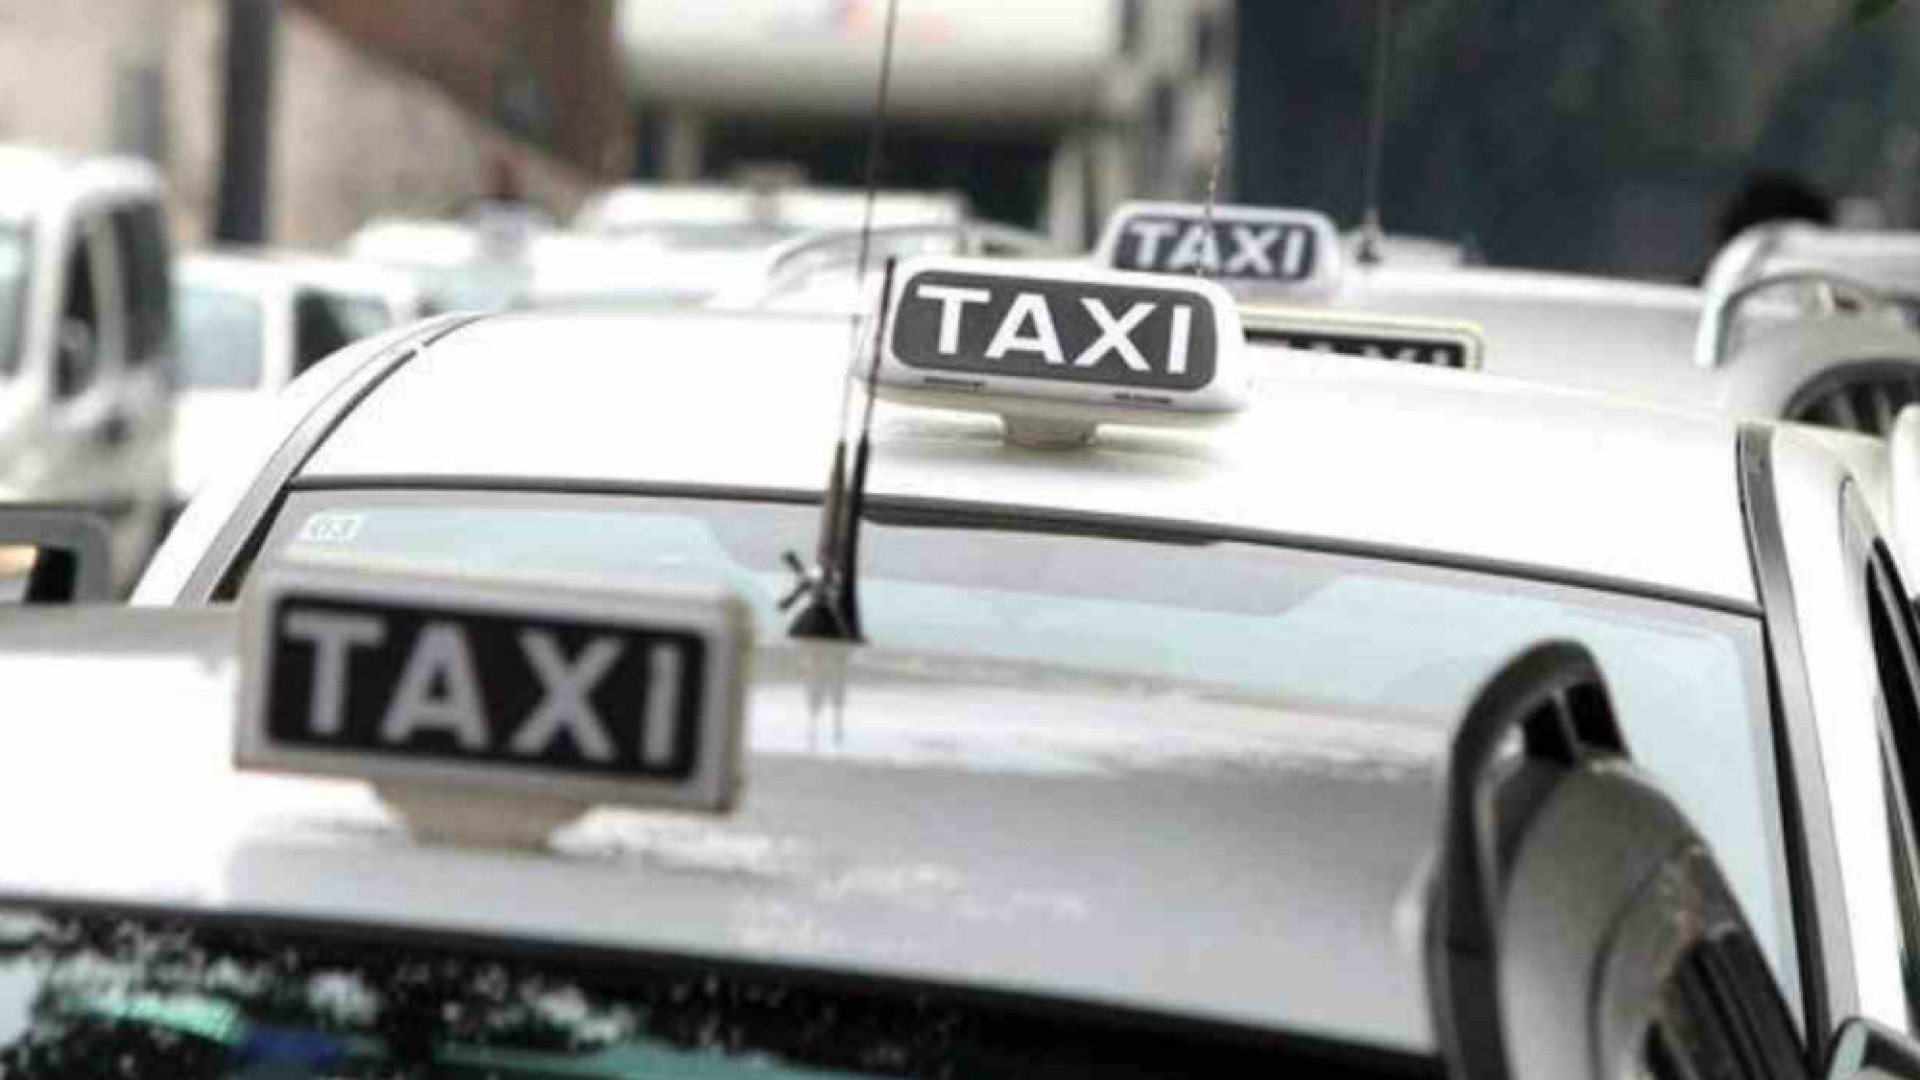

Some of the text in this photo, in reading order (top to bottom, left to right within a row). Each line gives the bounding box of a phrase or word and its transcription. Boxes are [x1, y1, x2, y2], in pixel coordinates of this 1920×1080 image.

[1125, 222, 1304, 274] TAXI
[917, 285, 1192, 374] TAXI
[284, 612, 683, 765] TAXI
